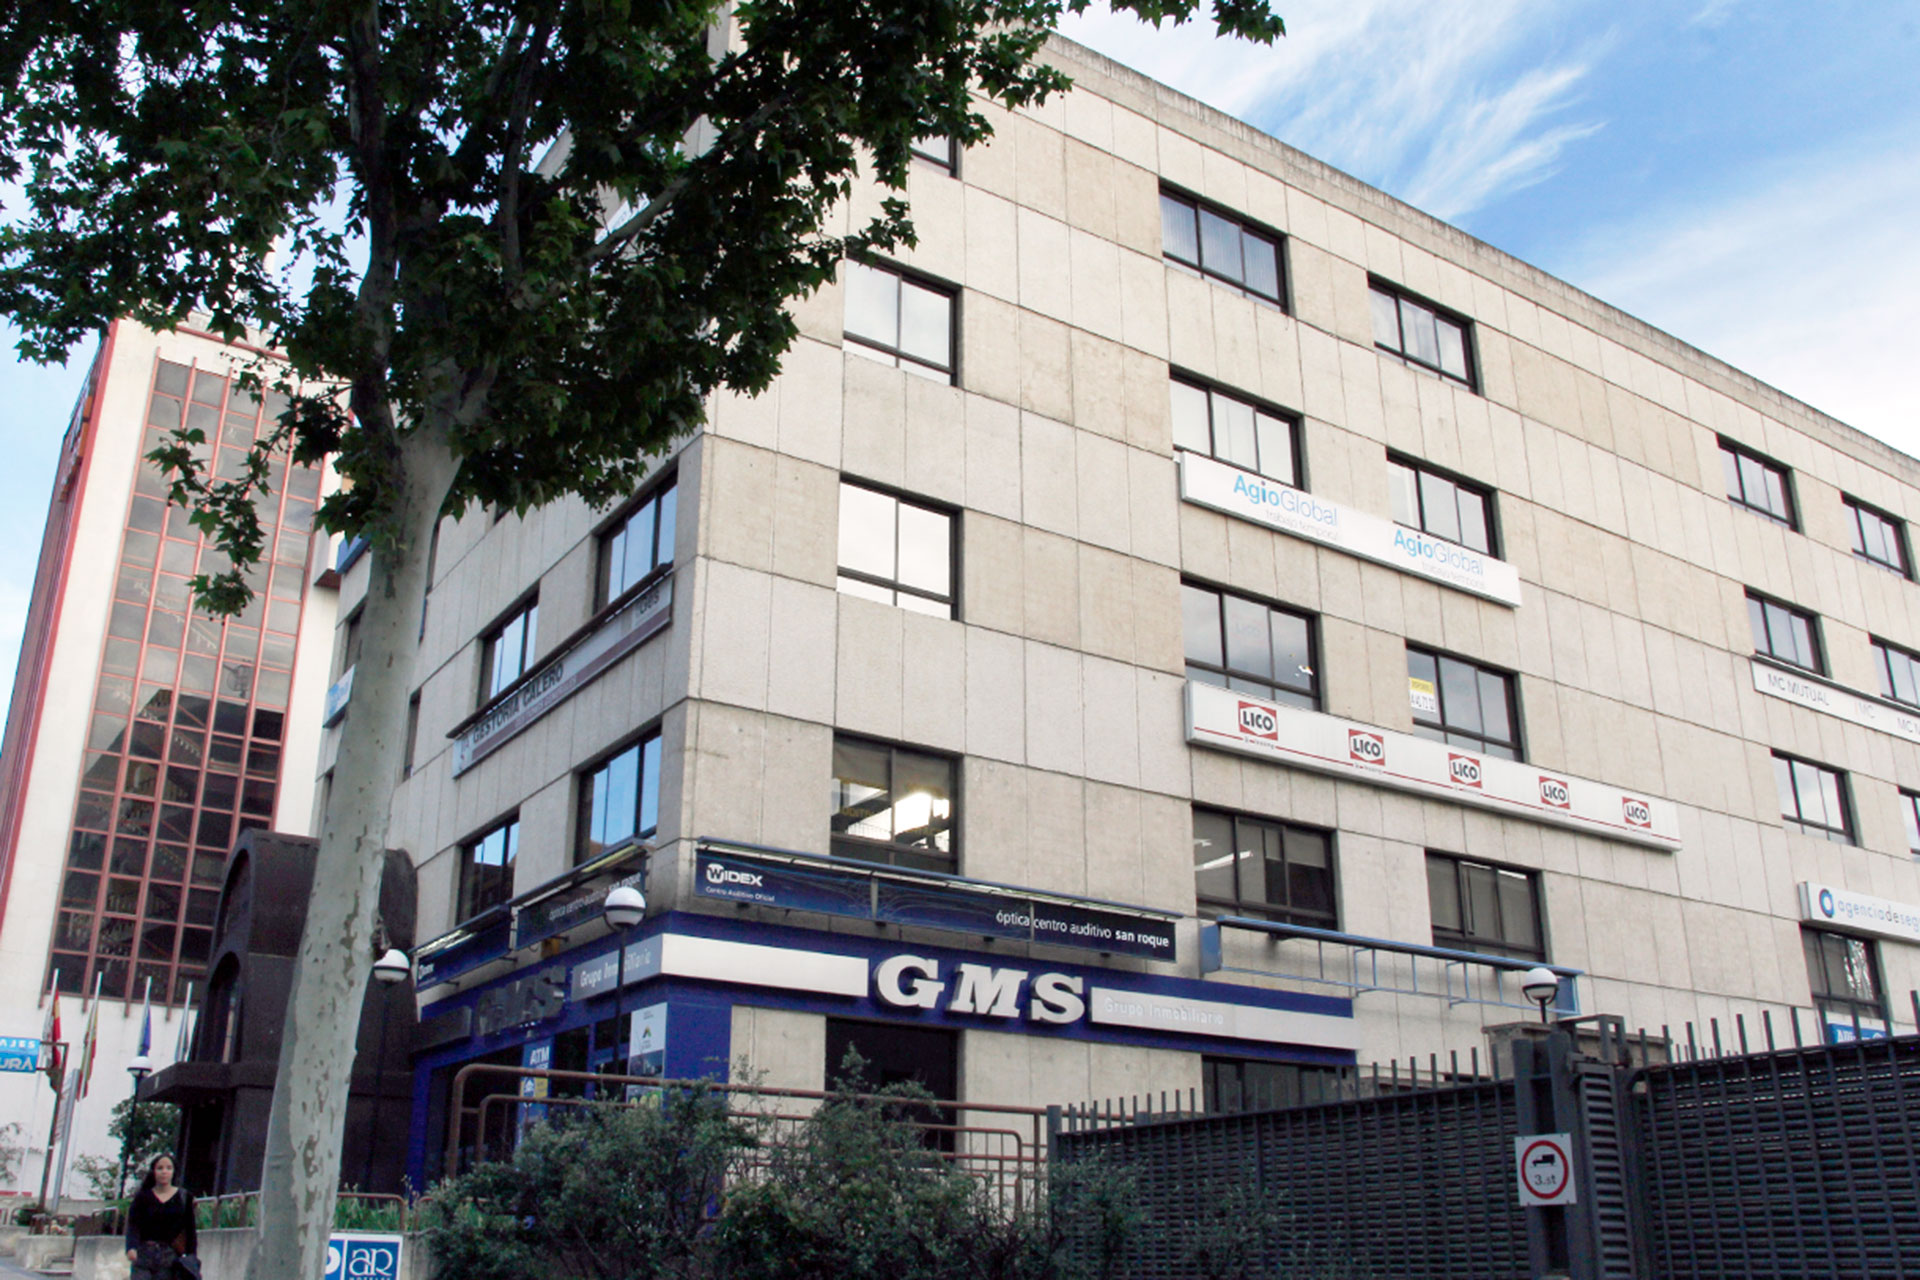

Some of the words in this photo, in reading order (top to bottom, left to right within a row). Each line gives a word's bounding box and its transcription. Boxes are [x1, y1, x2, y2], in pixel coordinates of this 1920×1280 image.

[1233, 474, 1337, 527] AgioGlobal
[1393, 528, 1484, 576] AgioGlobal
[473, 695, 521, 743] GESTORIA
[522, 662, 564, 704] CALERO
[1767, 673, 1785, 690] MC
[1786, 680, 1830, 706] MUTUAL
[1242, 710, 1274, 731] LICO
[1352, 737, 1381, 758] LICO
[1452, 762, 1478, 780] LICO
[1543, 785, 1566, 801] LICO
[1626, 806, 1648, 821] LICO
[706, 863, 763, 887] WIDEX
[1034, 916, 1067, 932] centro
[1070, 922, 1111, 940] auditivo
[1115, 929, 1135, 942] san
[1138, 934, 1169, 948] roque
[875, 954, 1085, 1024] GMS
[1104, 997, 1144, 1017] Grupo
[1149, 1003, 1225, 1026] Inmobiliario
[530, 1045, 550, 1065] ATM
